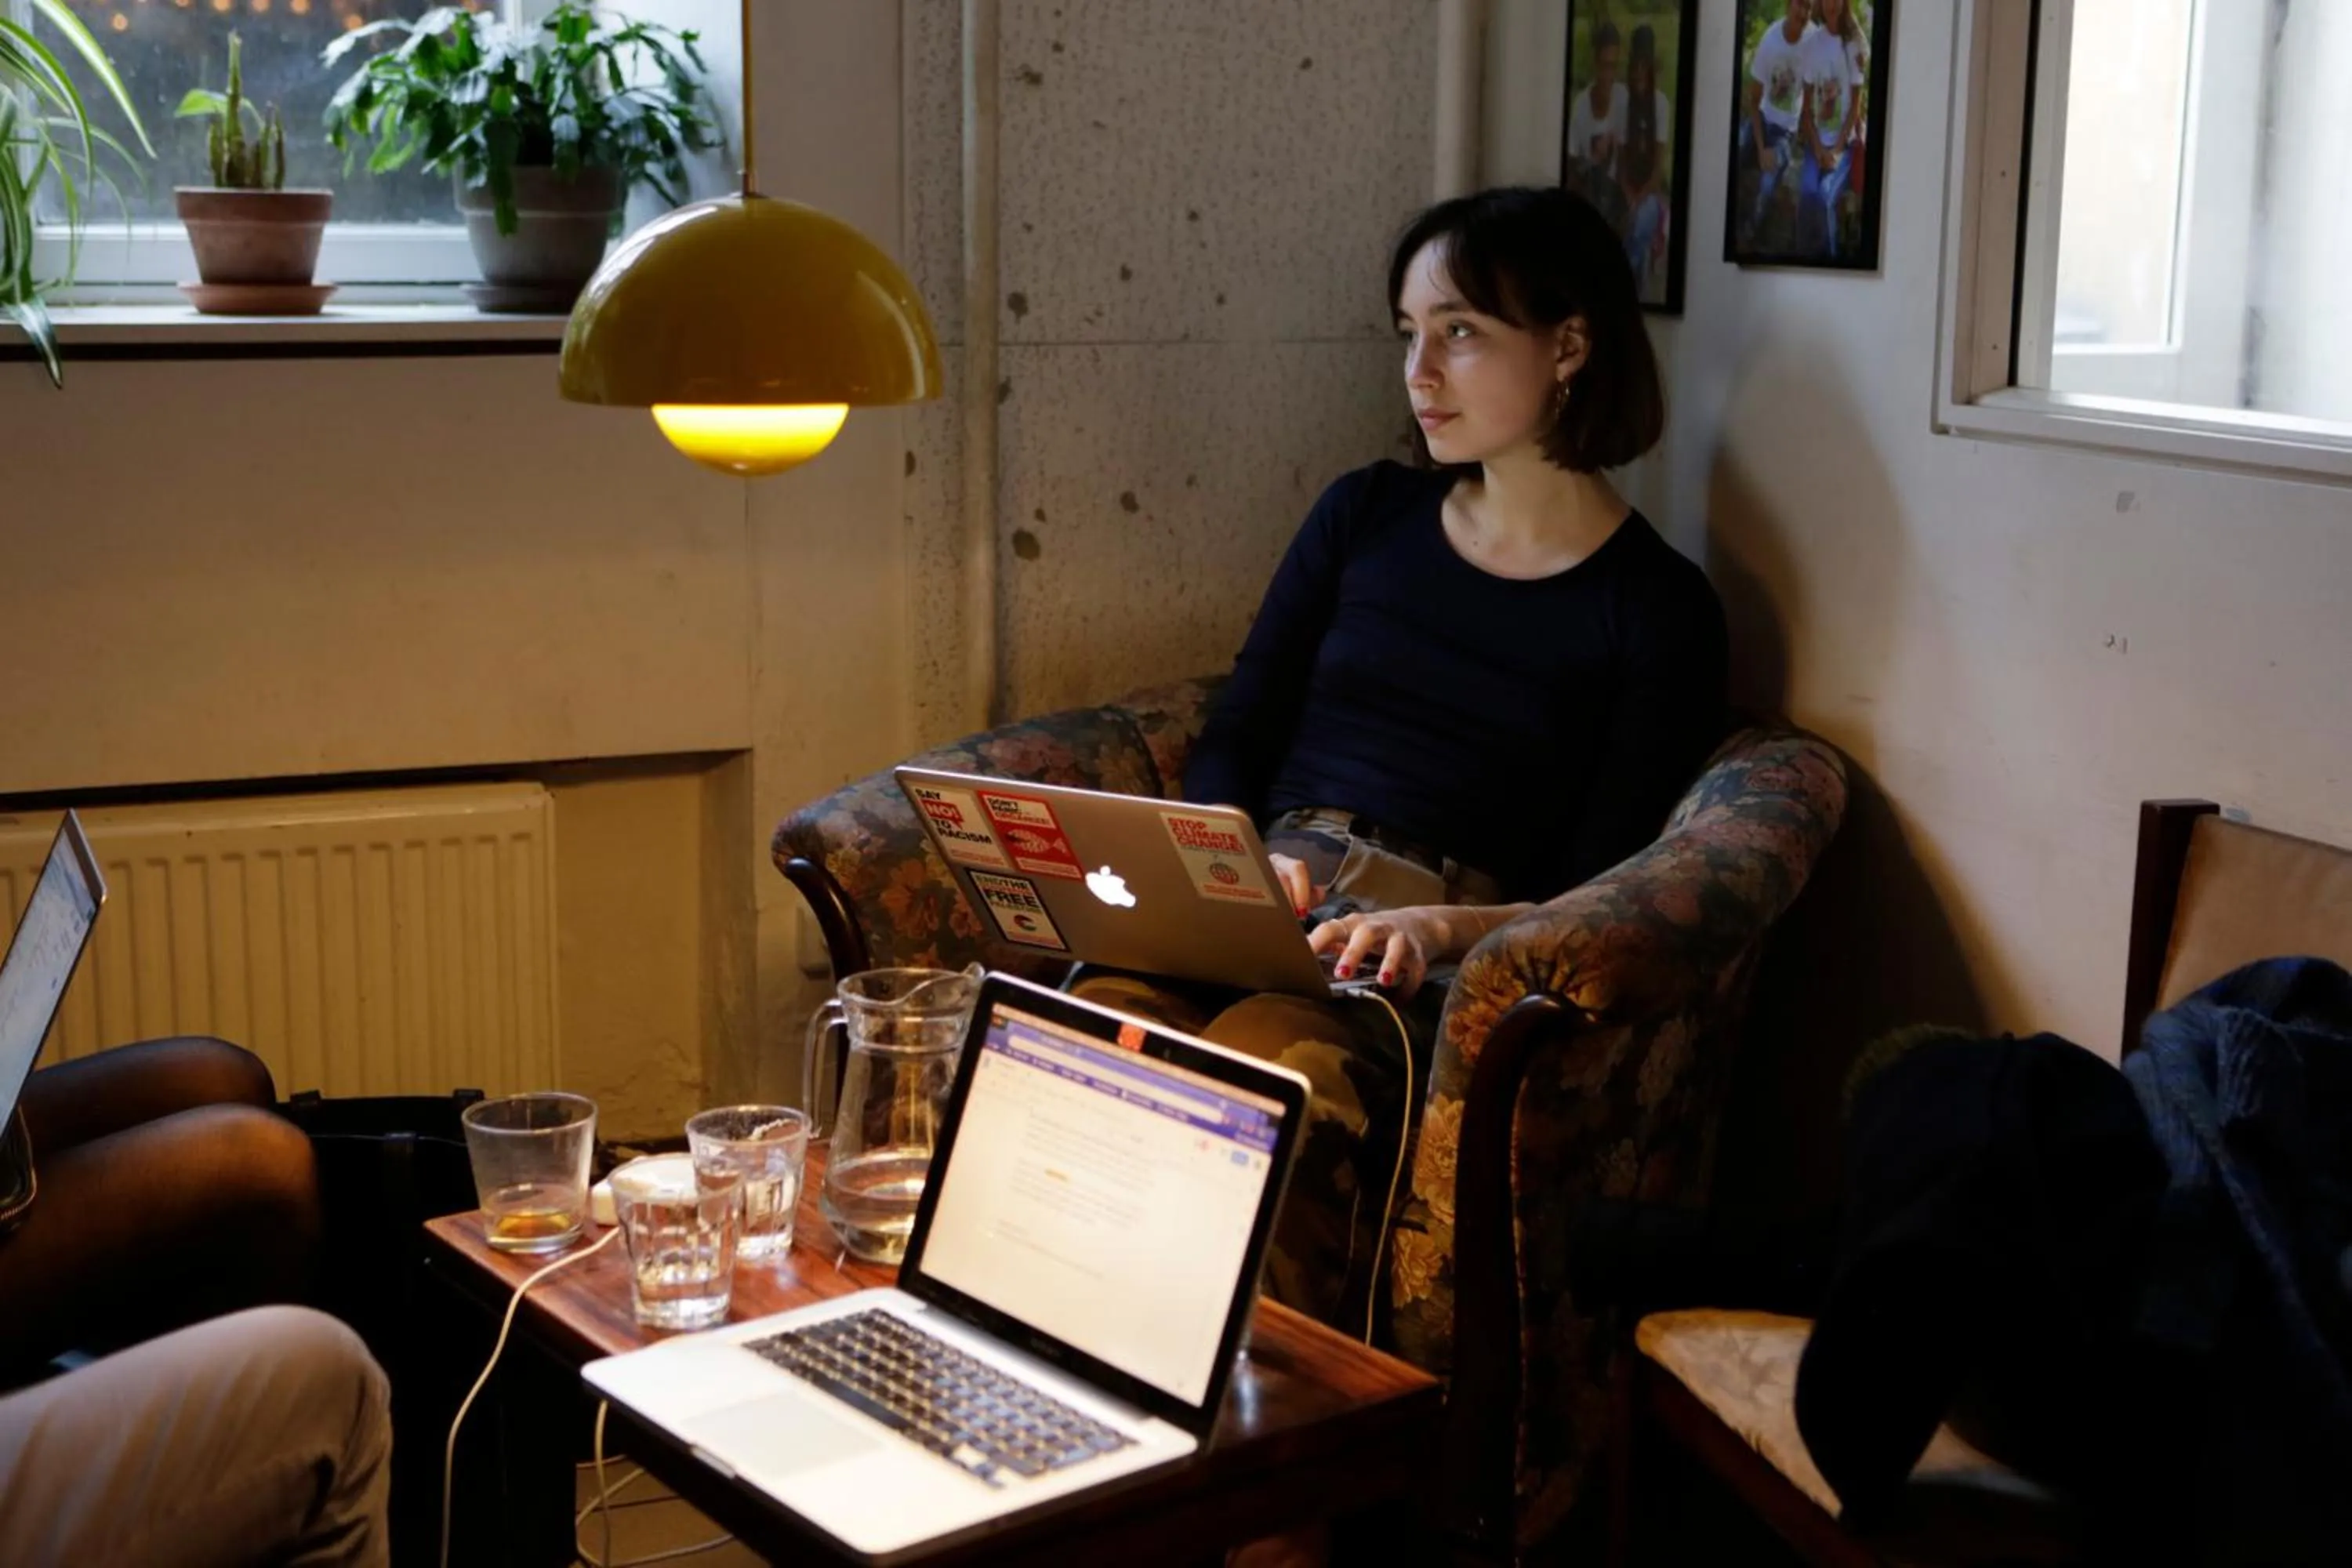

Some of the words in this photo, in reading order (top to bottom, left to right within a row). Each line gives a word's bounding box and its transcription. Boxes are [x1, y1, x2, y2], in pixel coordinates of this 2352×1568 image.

[915, 788, 941, 800] SAY
[925, 802, 960, 818] NO!
[932, 818, 952, 829] TO
[1167, 818, 1207, 830] STOP
[938, 827, 993, 844] RACISM
[982, 887, 1041, 909] FREE
